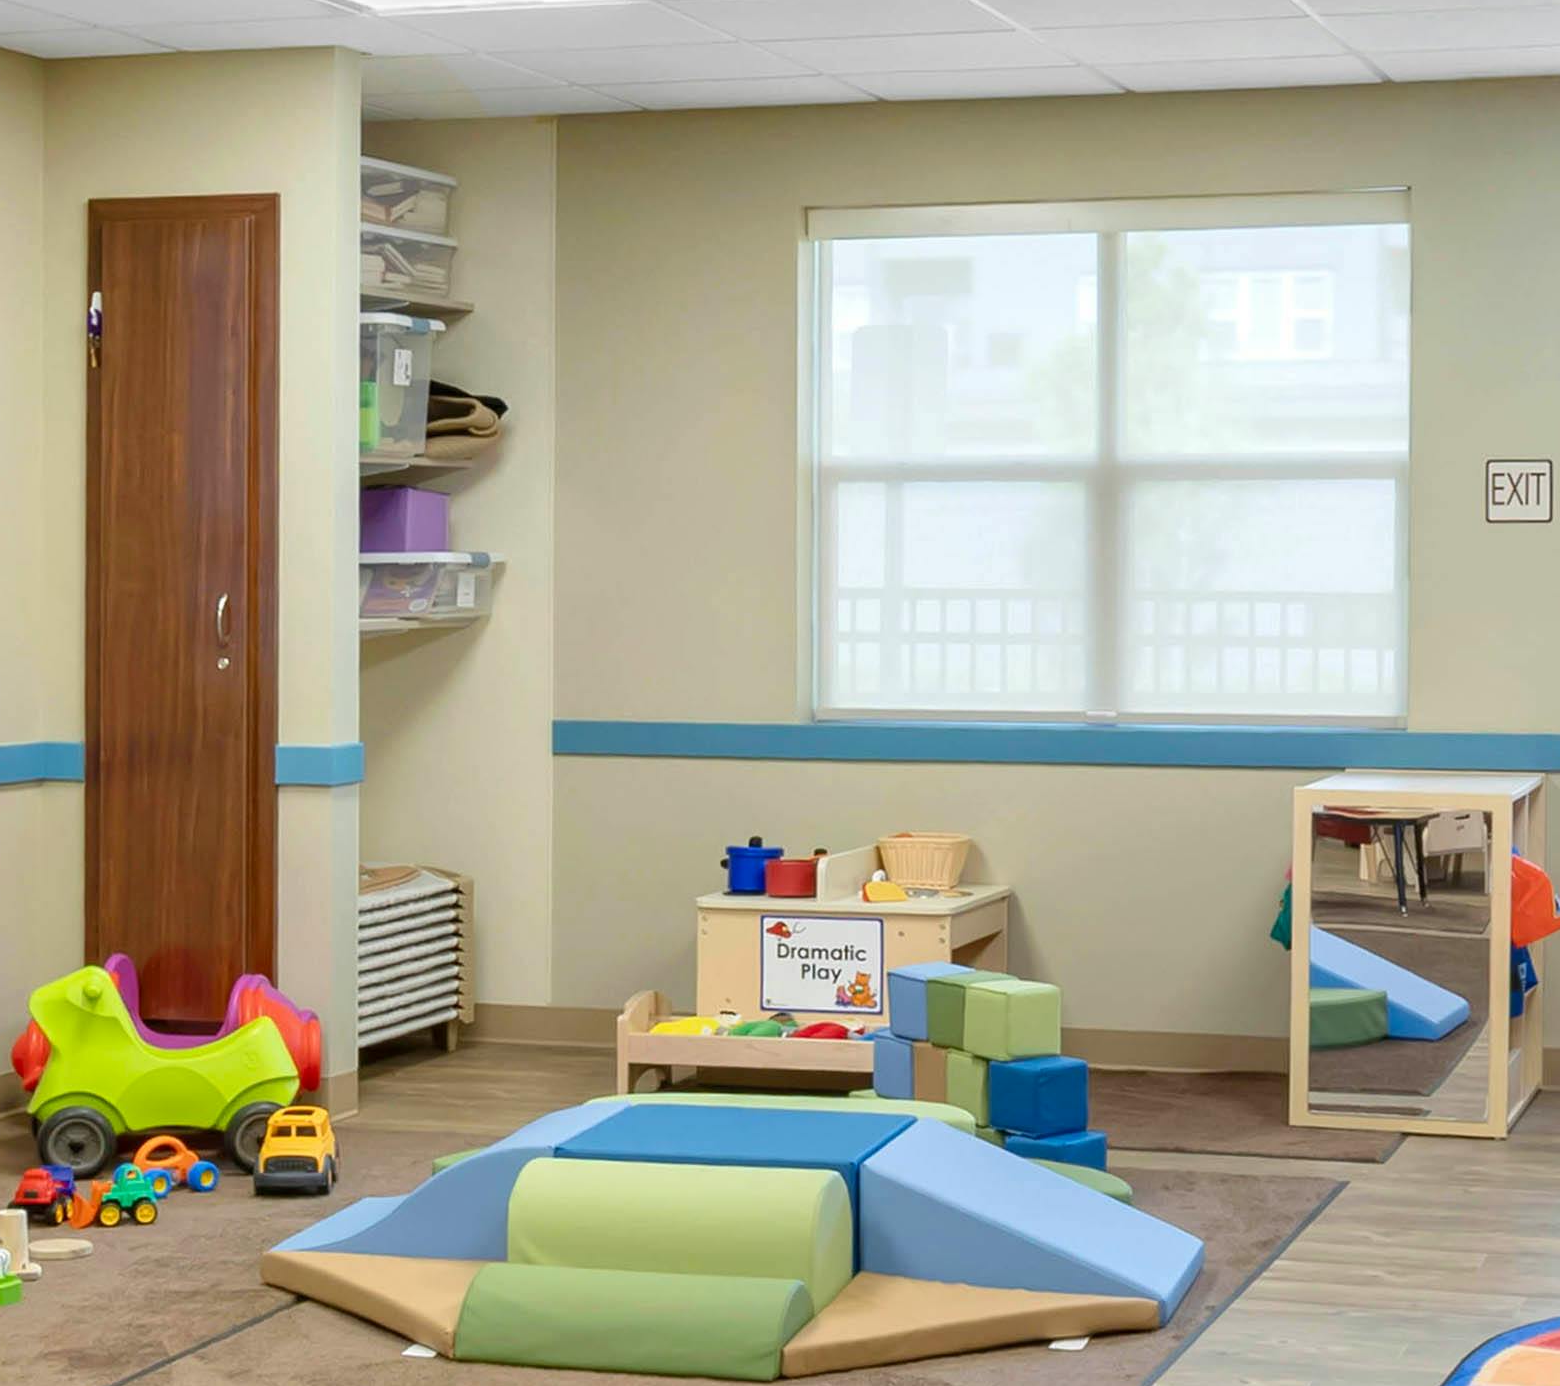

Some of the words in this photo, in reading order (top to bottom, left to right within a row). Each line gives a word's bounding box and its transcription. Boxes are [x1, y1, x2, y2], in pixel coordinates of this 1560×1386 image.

[1492, 472, 1546, 505] EXIT
[777, 943, 867, 961] Dramatic
[801, 963, 842, 984] Play
